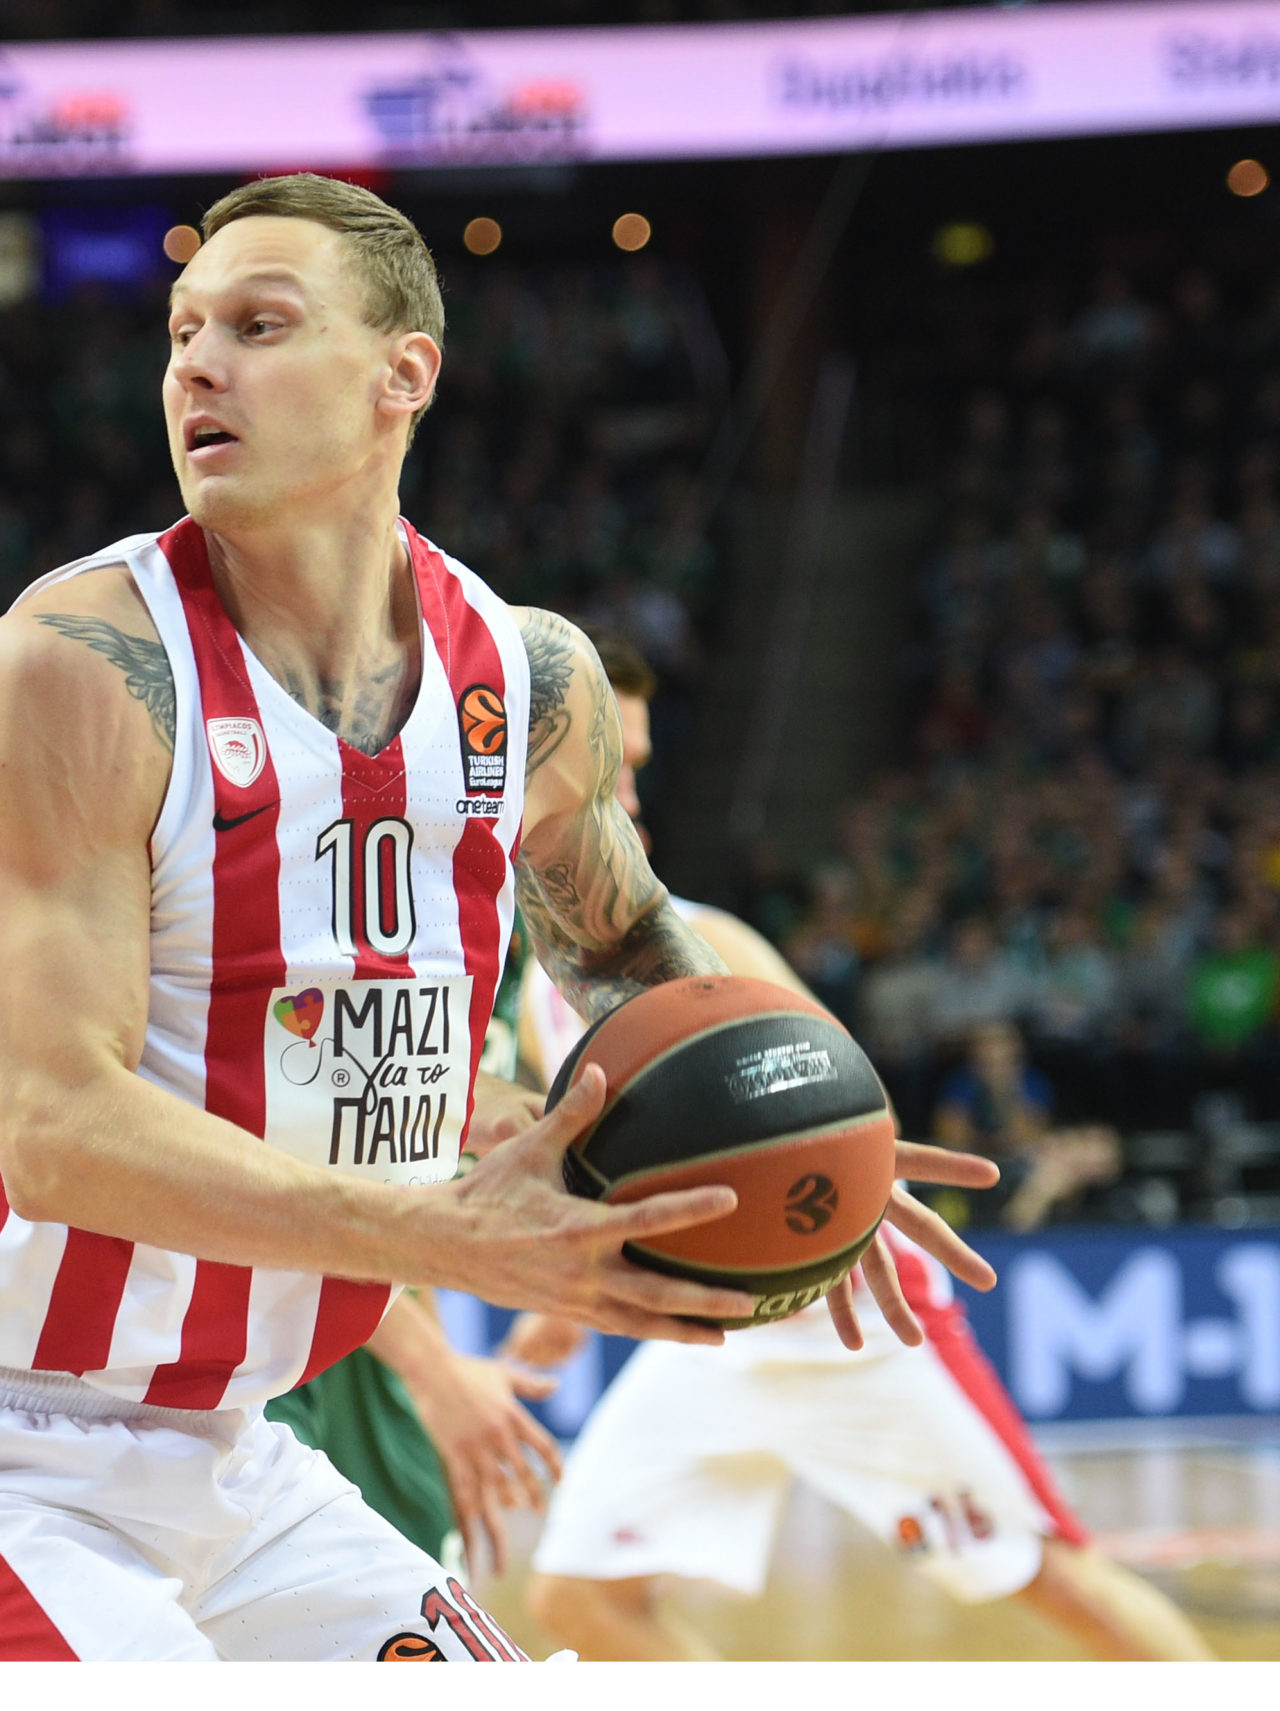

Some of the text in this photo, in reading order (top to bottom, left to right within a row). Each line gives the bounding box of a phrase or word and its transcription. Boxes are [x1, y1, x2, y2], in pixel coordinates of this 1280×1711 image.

[468, 755, 504, 767] TURKISH
[469, 766, 505, 777] AIRLINES
[314, 815, 416, 957] 10
